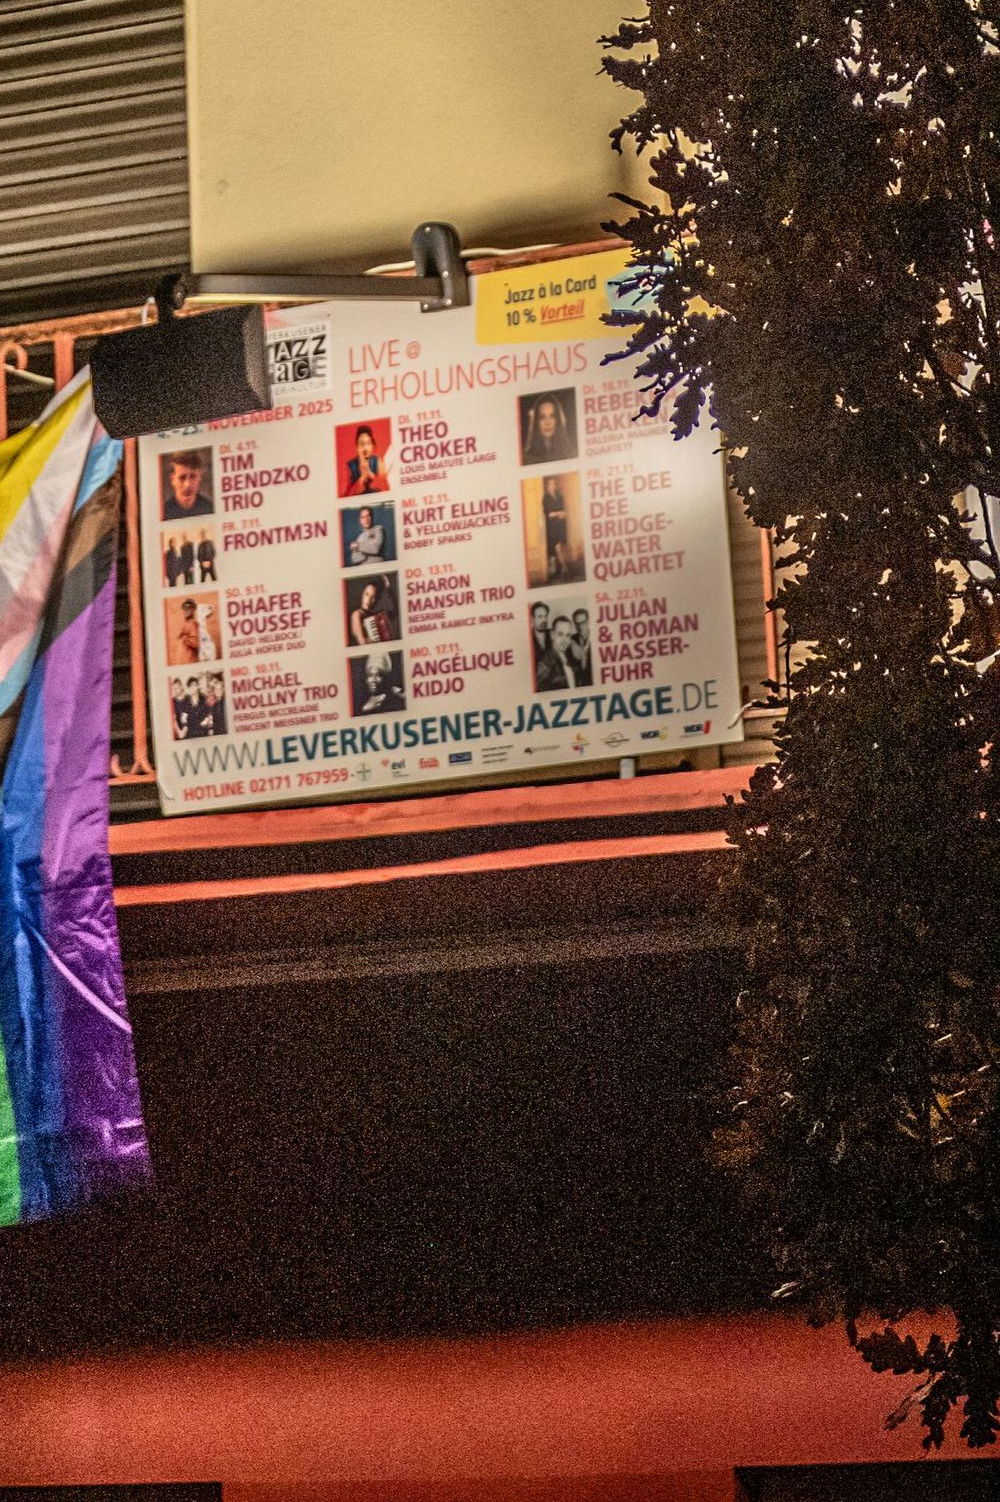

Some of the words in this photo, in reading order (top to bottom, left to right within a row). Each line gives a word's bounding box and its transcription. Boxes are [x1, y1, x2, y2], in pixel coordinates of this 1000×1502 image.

[505, 288, 534, 305] Jazz
[550, 281, 562, 297] la
[566, 275, 597, 294] Card
[506, 310, 520, 327] 10
[524, 308, 537, 323] %
[540, 300, 585, 323] Vorteil
[348, 339, 401, 374] LIVE
[405, 340, 421, 359] @
[349, 342, 588, 409] ERHOLUNGSHAUS
[298, 399, 333, 417] 2025
[399, 421, 449, 444] THEO
[221, 452, 254, 473] TIM
[400, 436, 477, 464] CROKER
[400, 464, 426, 475] LOUIS
[428, 457, 464, 470] MATUTE
[467, 451, 497, 465] LARGE
[222, 464, 310, 493] BENDZKO
[400, 470, 448, 485] ENSEMBLE
[588, 477, 625, 499] THE
[631, 470, 672, 493] DEE
[222, 491, 264, 512] TRIO
[403, 506, 445, 526] KURT
[451, 496, 509, 519] ELLING
[589, 497, 628, 519] DEE
[224, 520, 328, 552] FRONTM3N
[403, 528, 412, 538] &
[416, 512, 510, 536] YELLOWJACKETS
[591, 512, 673, 540] BRIDGE-
[404, 539, 434, 550] BOBBY
[437, 532, 473, 546] SPARKS
[592, 534, 661, 560] WATER
[593, 550, 686, 582] QUARTET
[406, 574, 470, 596] SHARON
[227, 592, 302, 618] DHAFER
[408, 591, 475, 613] MANSUR
[480, 585, 515, 603] TRIO
[597, 596, 667, 624] JULIAN
[228, 610, 311, 637] YOUSSEF
[409, 610, 446, 623] NESRINE
[409, 623, 438, 634] EMMA
[598, 625, 613, 643] &
[620, 612, 699, 641] ROMAN
[229, 647, 253, 658] JULIA
[410, 646, 431, 658] MO.
[598, 636, 690, 664] WASSER-
[412, 649, 514, 678] ANGÉLIQUE
[600, 661, 654, 685] FUHR
[231, 672, 303, 695] MICHAEL
[413, 677, 464, 698] KIDJO
[232, 689, 298, 711] WOLLNY
[303, 684, 339, 703] TRIO
[173, 679, 719, 777] WWW.LEVERKUSENER-JAZZTAGE.DE
[234, 711, 266, 722] FERGUS
[234, 721, 271, 733] VINCENT
[319, 712, 340, 723] TRIO
[184, 781, 244, 801] HOTLINE
[249, 775, 291, 793] 02171
[297, 767, 349, 787] 767959
